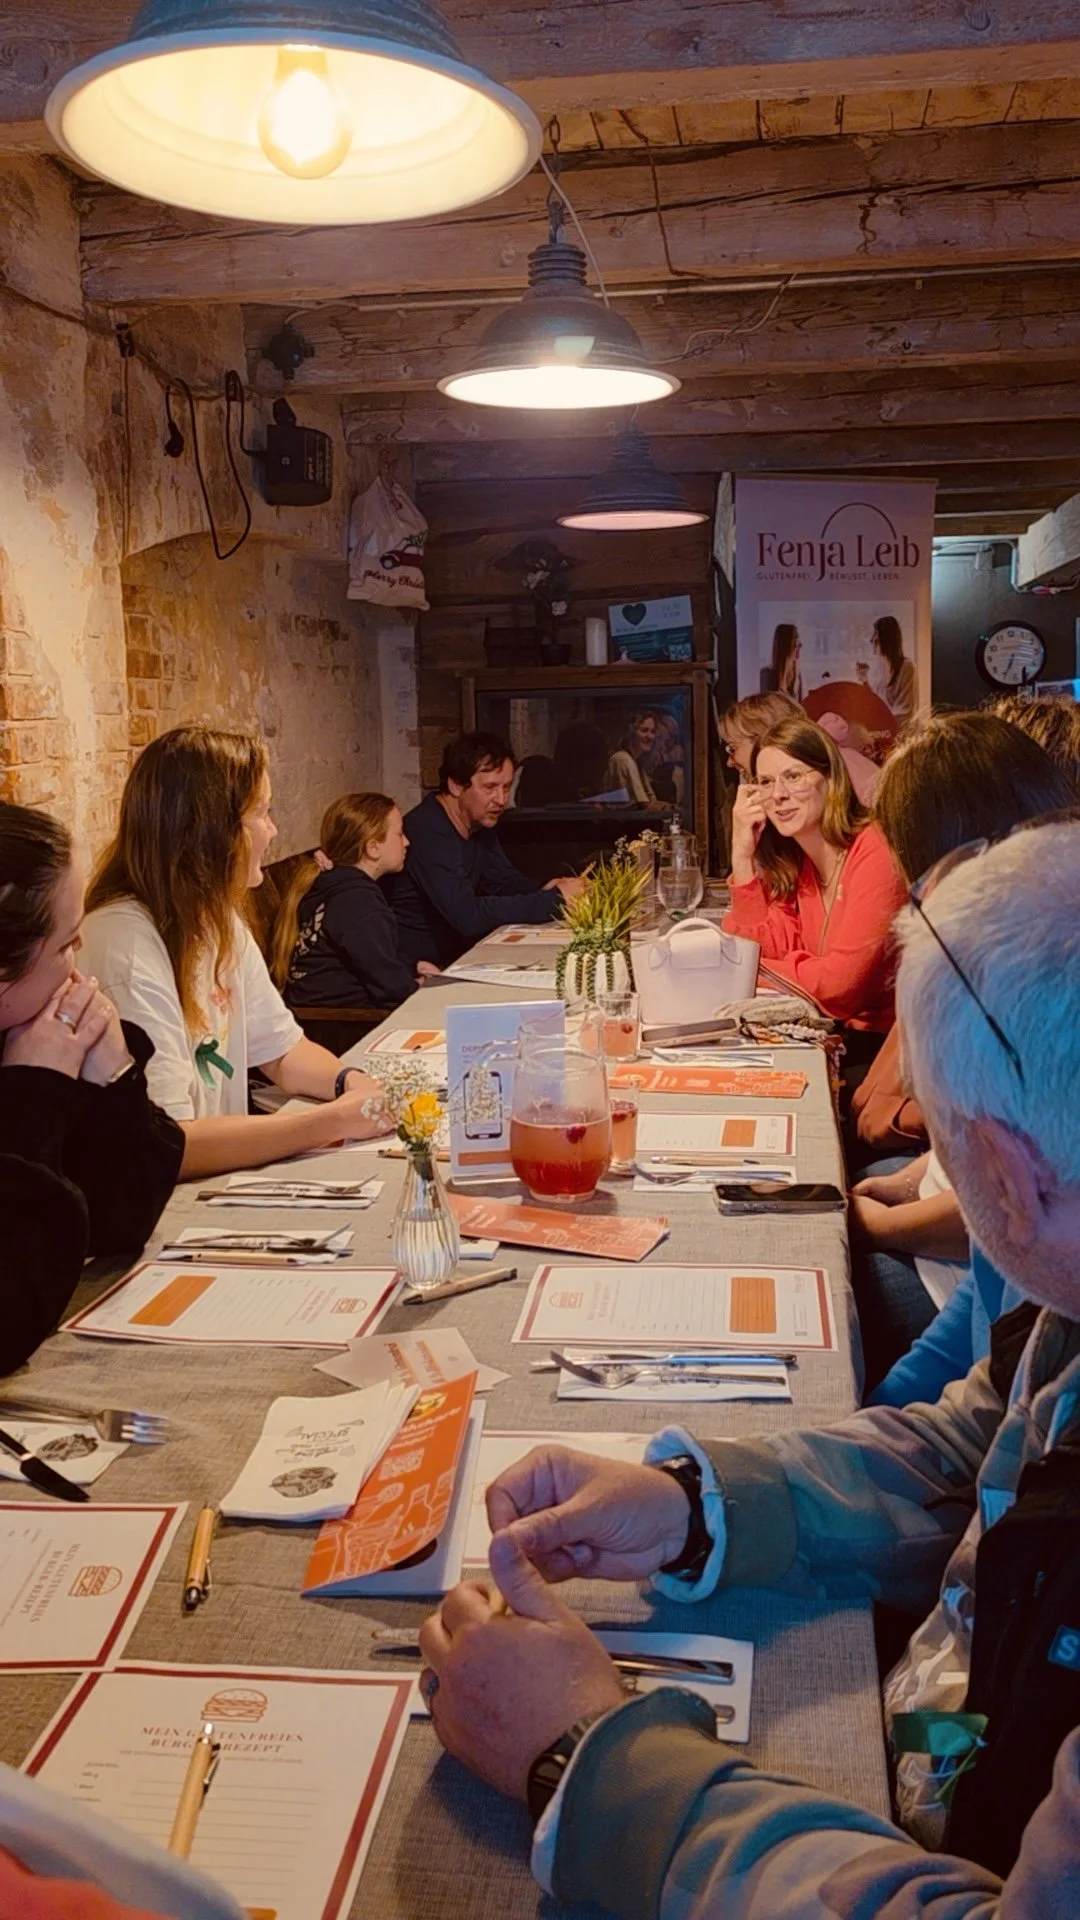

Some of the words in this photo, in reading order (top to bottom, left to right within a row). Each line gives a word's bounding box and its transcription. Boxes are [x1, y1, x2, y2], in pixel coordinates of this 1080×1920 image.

[757, 533, 847, 582] Fenja
[856, 534, 920, 569] Leib
[143, 1726, 180, 1737] MEIN
[186, 1729, 304, 1743] GTENFREIEN
